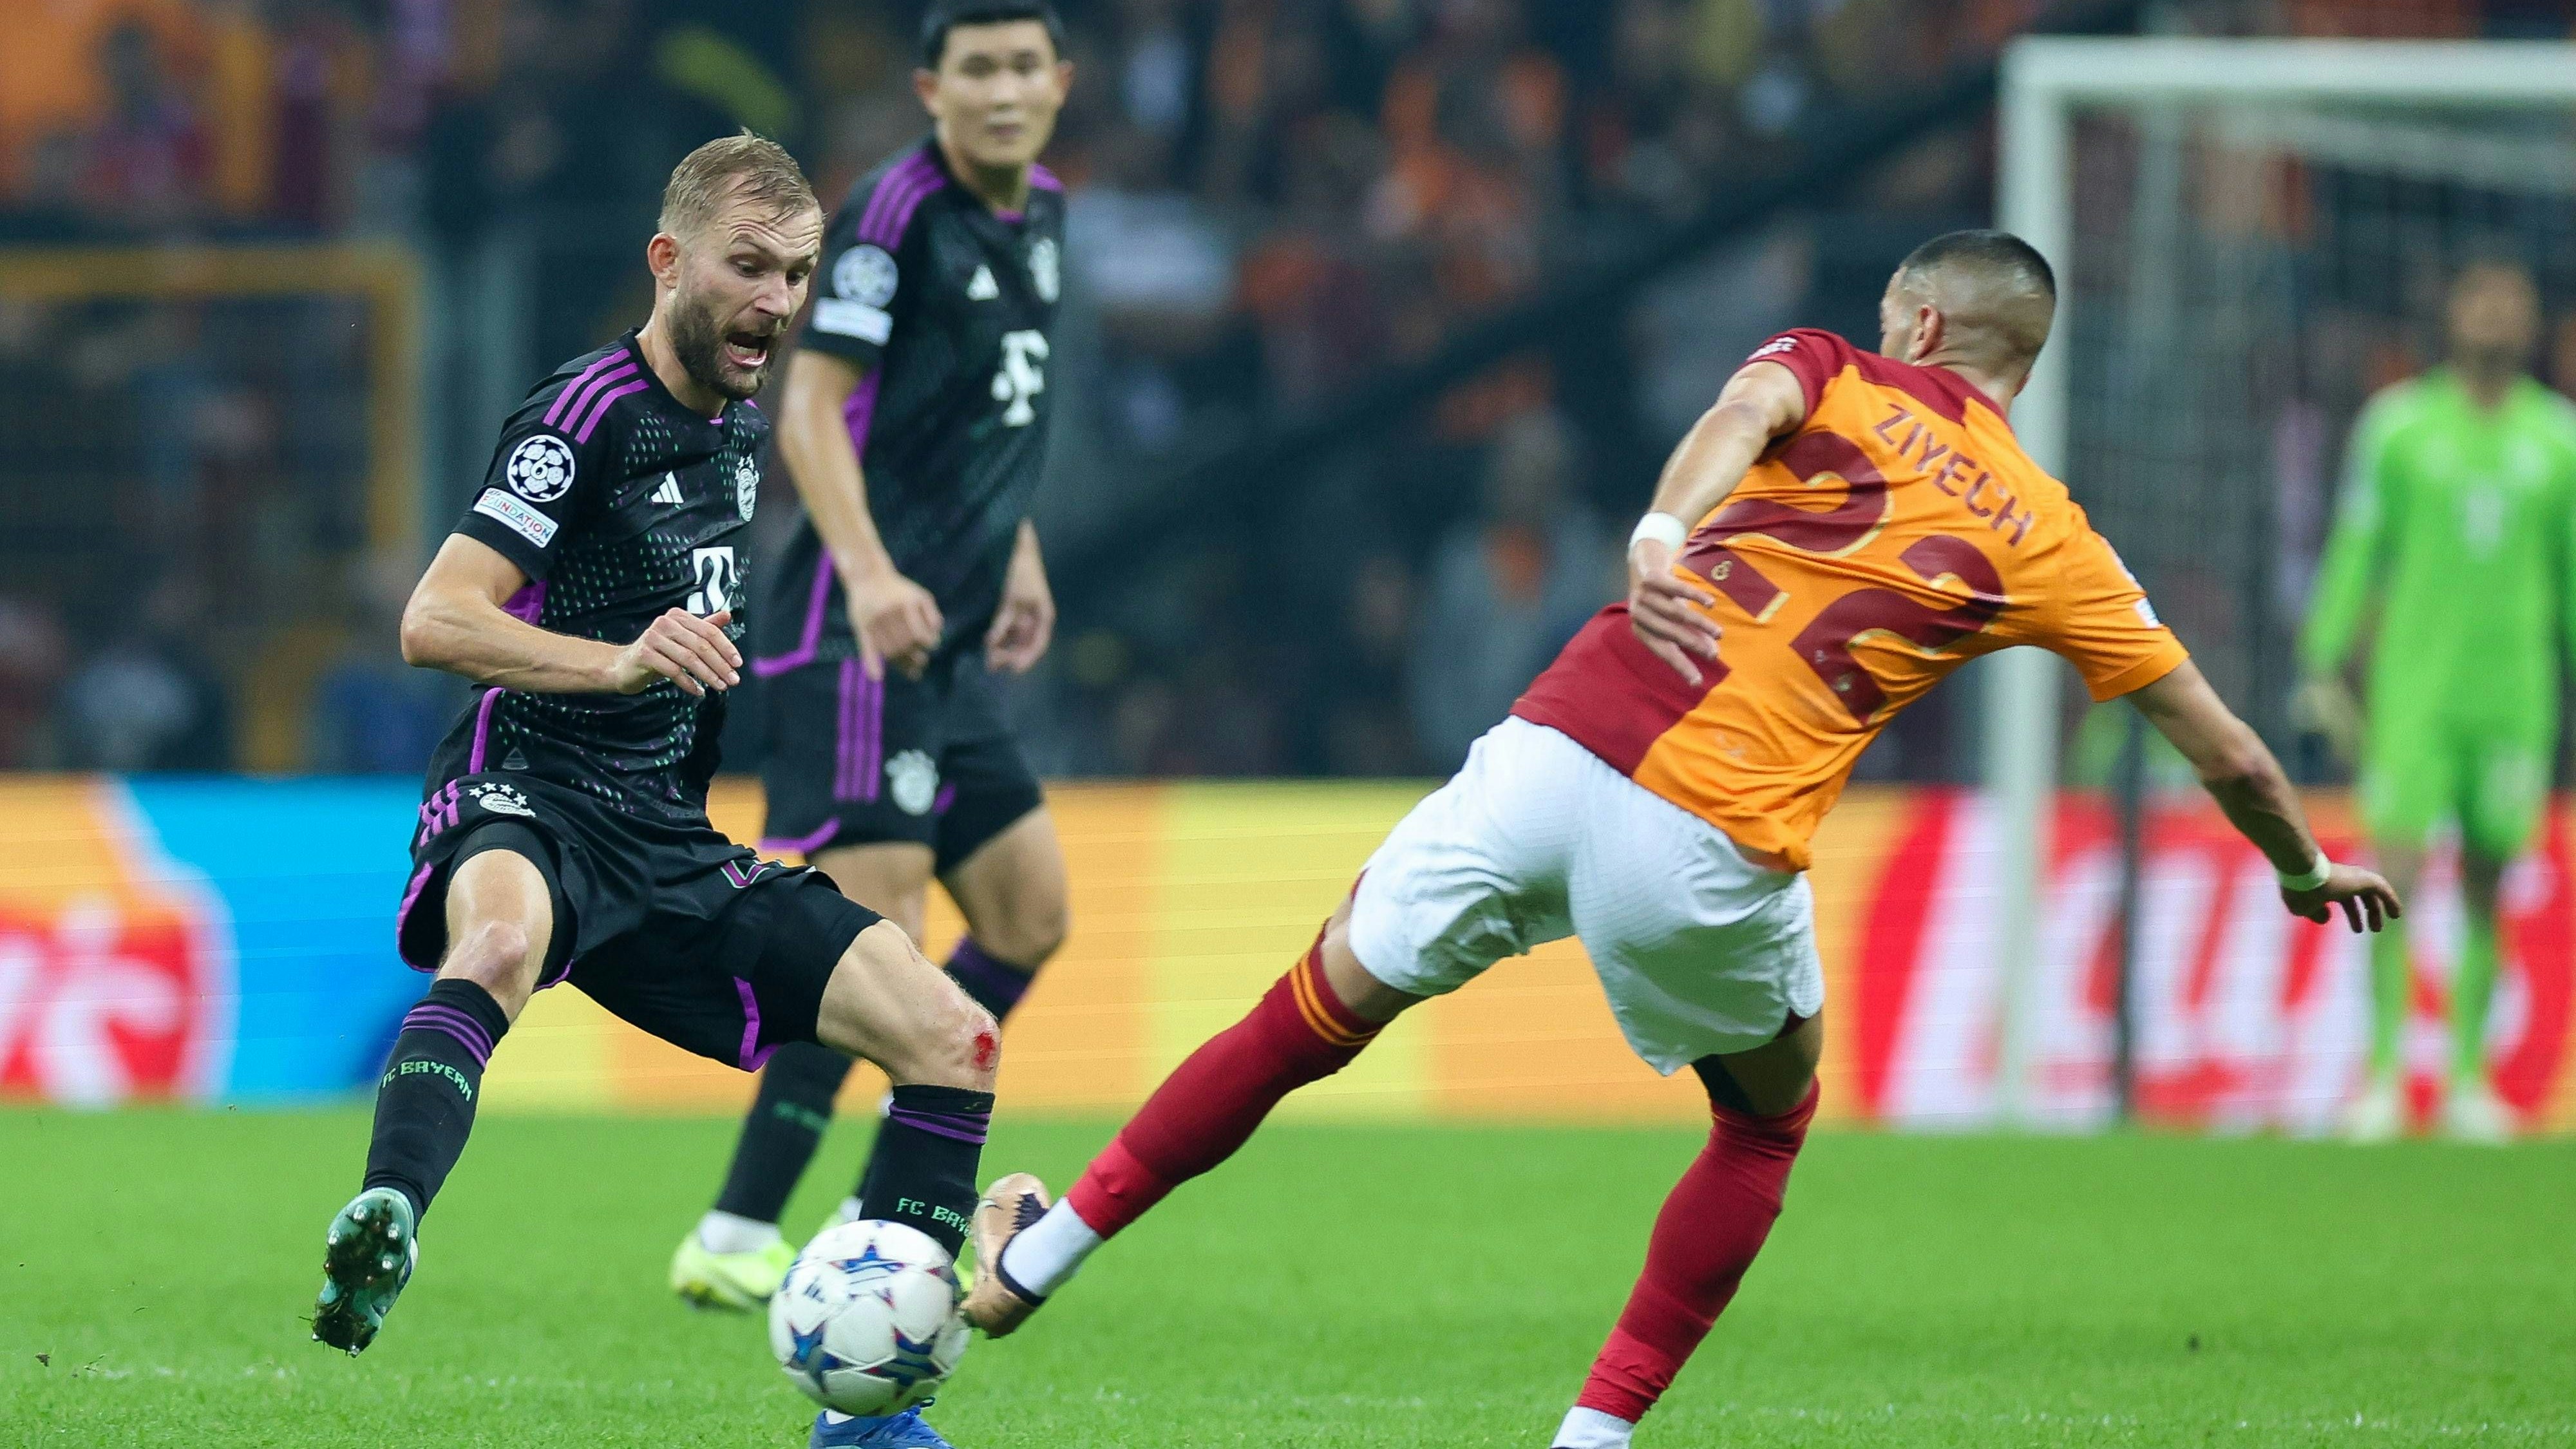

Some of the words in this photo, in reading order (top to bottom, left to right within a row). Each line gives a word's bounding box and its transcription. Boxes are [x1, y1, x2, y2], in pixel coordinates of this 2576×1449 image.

[529, 456, 549, 480] 6
[1873, 402, 2034, 548] ZIYECH
[482, 495, 552, 539] FOUNDATION
[1676, 430, 2009, 728] 22
[383, 1067, 397, 1088] FC
[400, 1061, 473, 1102] BAYERN
[896, 1197, 925, 1215] FC
